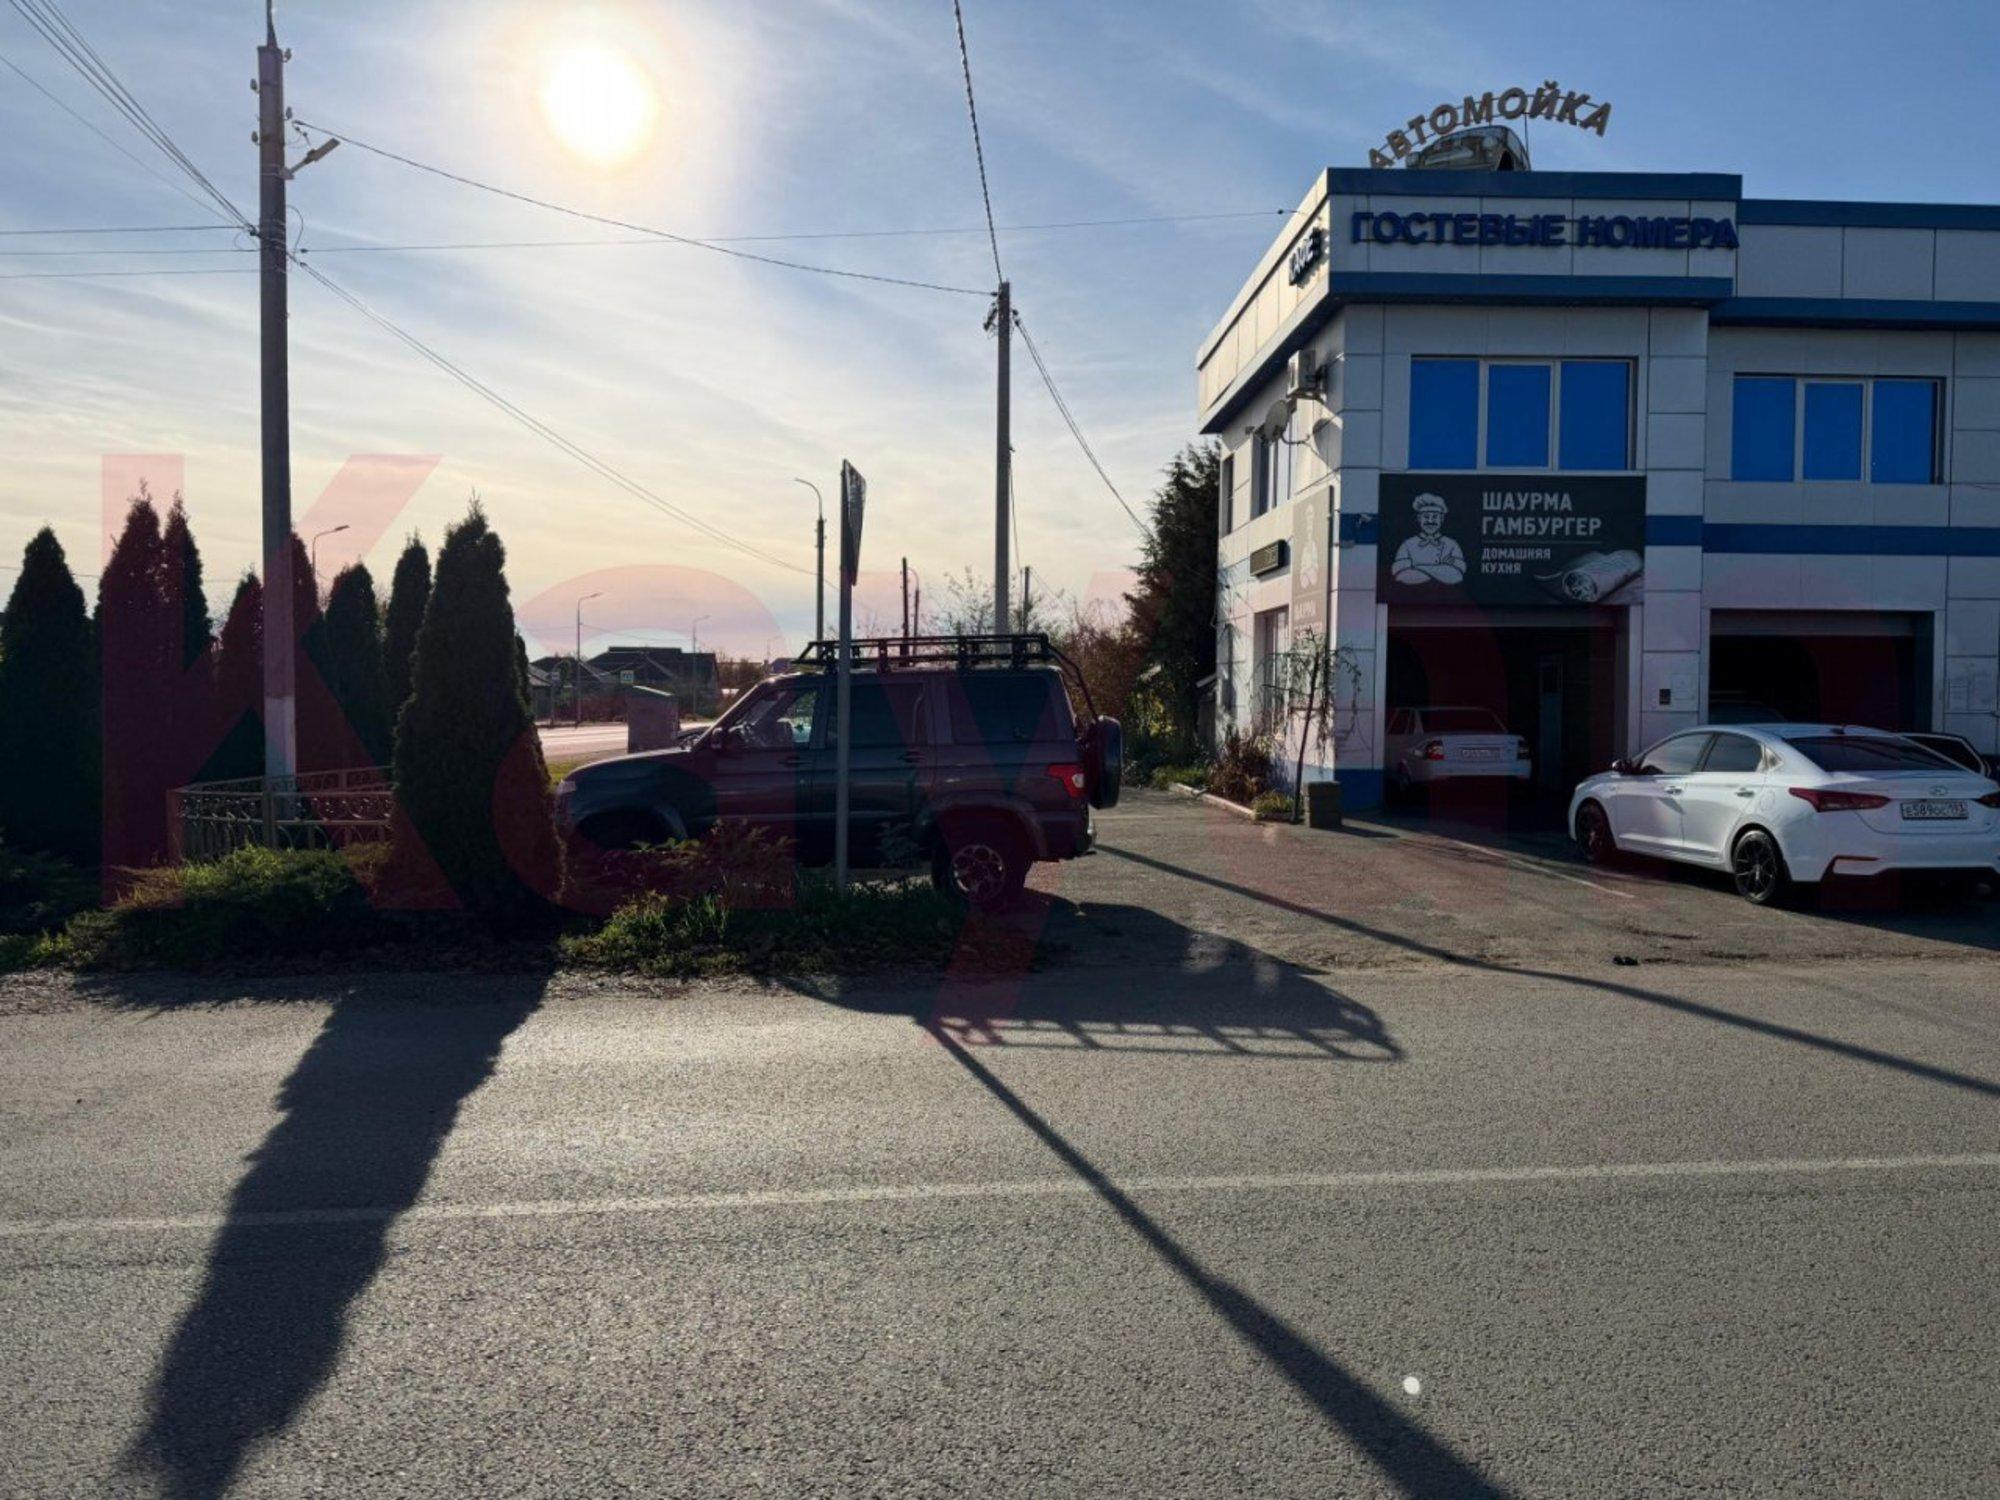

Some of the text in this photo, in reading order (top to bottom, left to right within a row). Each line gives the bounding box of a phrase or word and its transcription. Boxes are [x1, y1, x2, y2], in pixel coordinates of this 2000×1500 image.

[1368, 80, 1612, 168] АВТОМОЙКА
[1351, 211, 1740, 250] ГОСТЕВЫЕ НОМЕРА
[1482, 492, 1573, 511] ШАУРМА
[1482, 517, 1602, 536] ГАМБУРГЕР
[1481, 548, 1551, 561] ДОМАШНЯЯ
[1481, 563, 1522, 574] КУХНЯ
